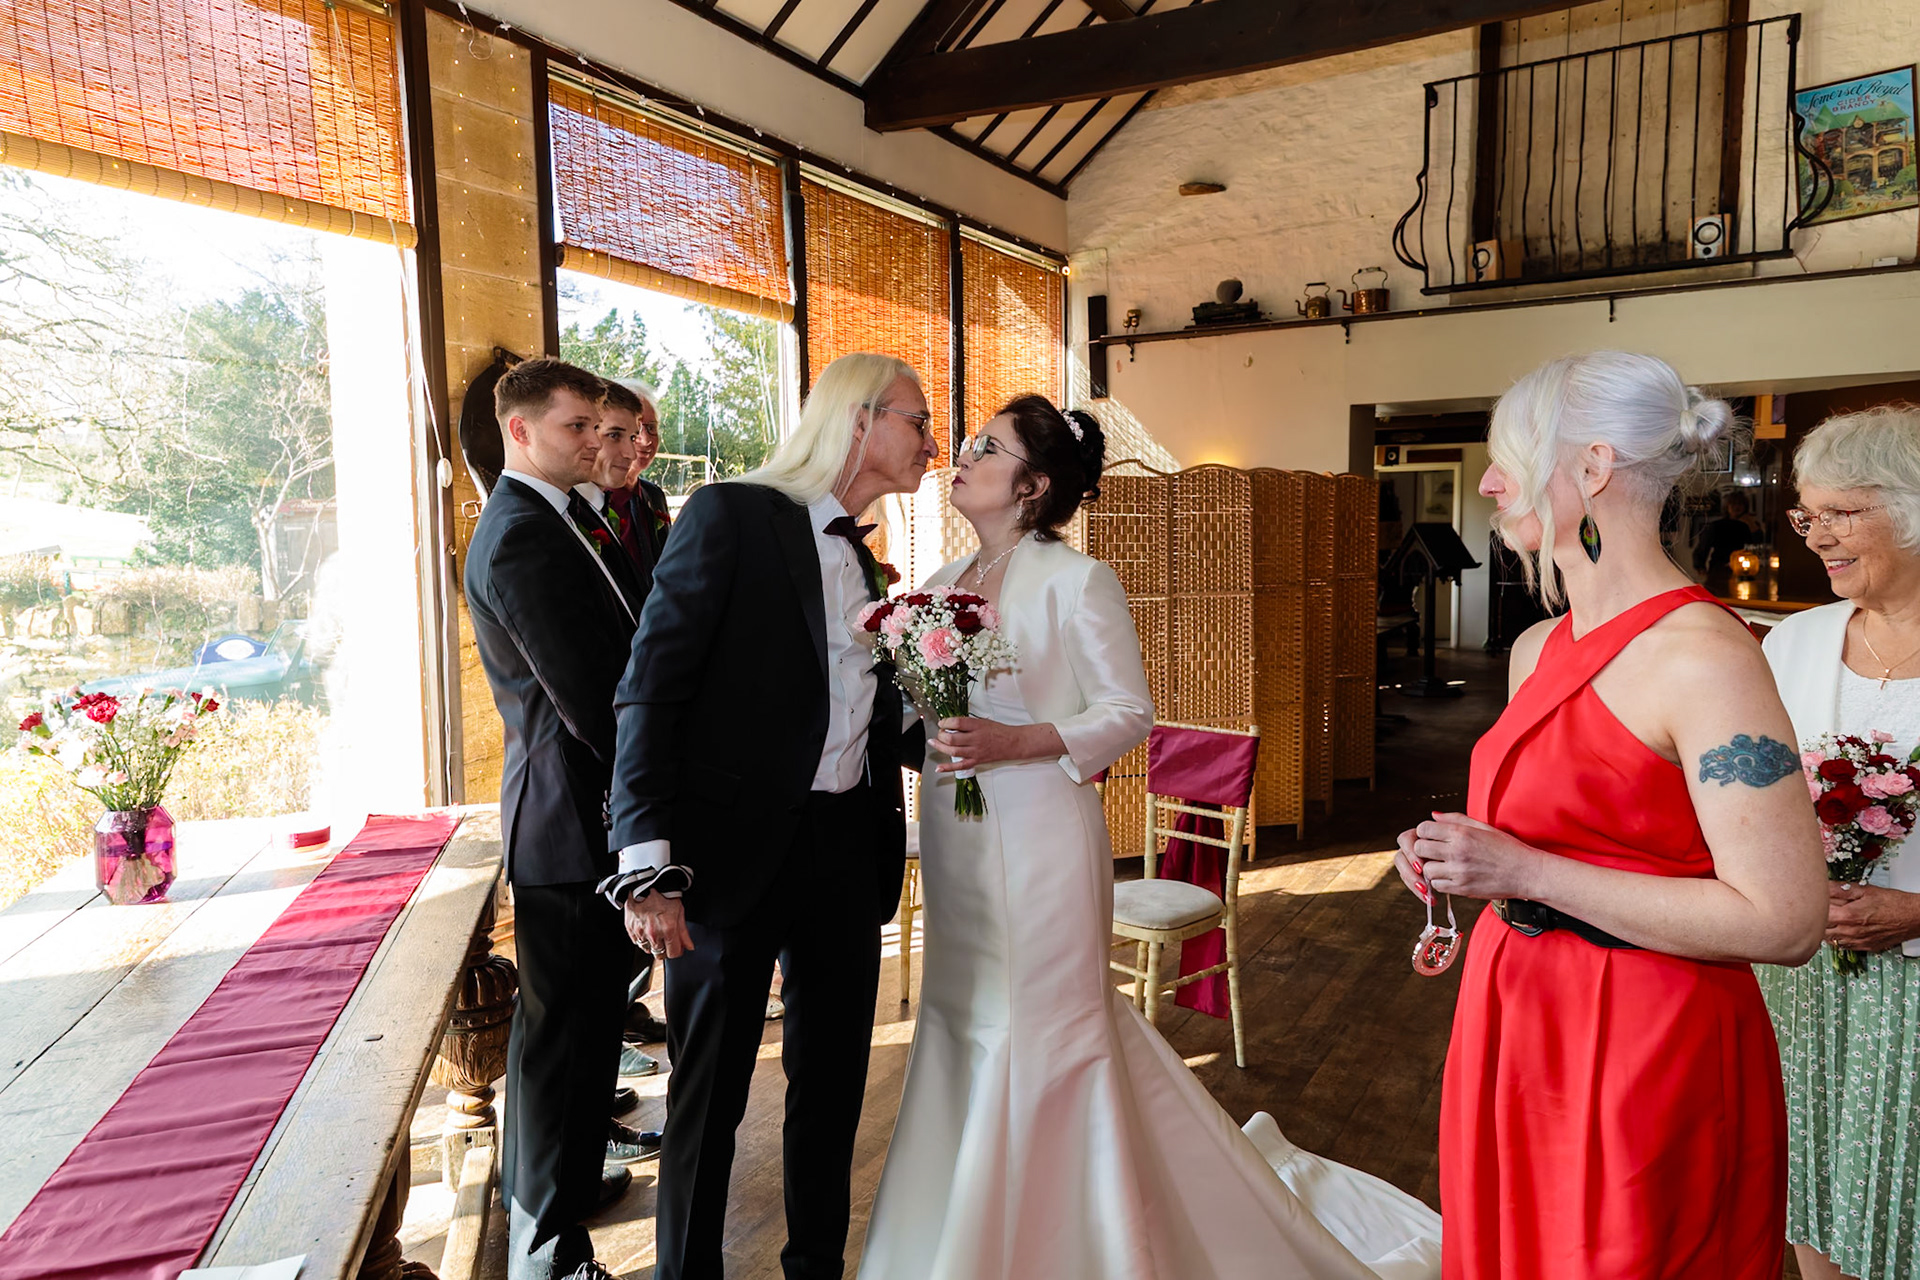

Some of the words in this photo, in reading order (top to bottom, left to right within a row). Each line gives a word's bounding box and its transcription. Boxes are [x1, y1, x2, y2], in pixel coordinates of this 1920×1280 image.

[1805, 84, 1863, 112] Somerset
[1863, 79, 1909, 98] Royal
[1837, 94, 1872, 106] CIDER
[1832, 99, 1876, 112] BRANDY
